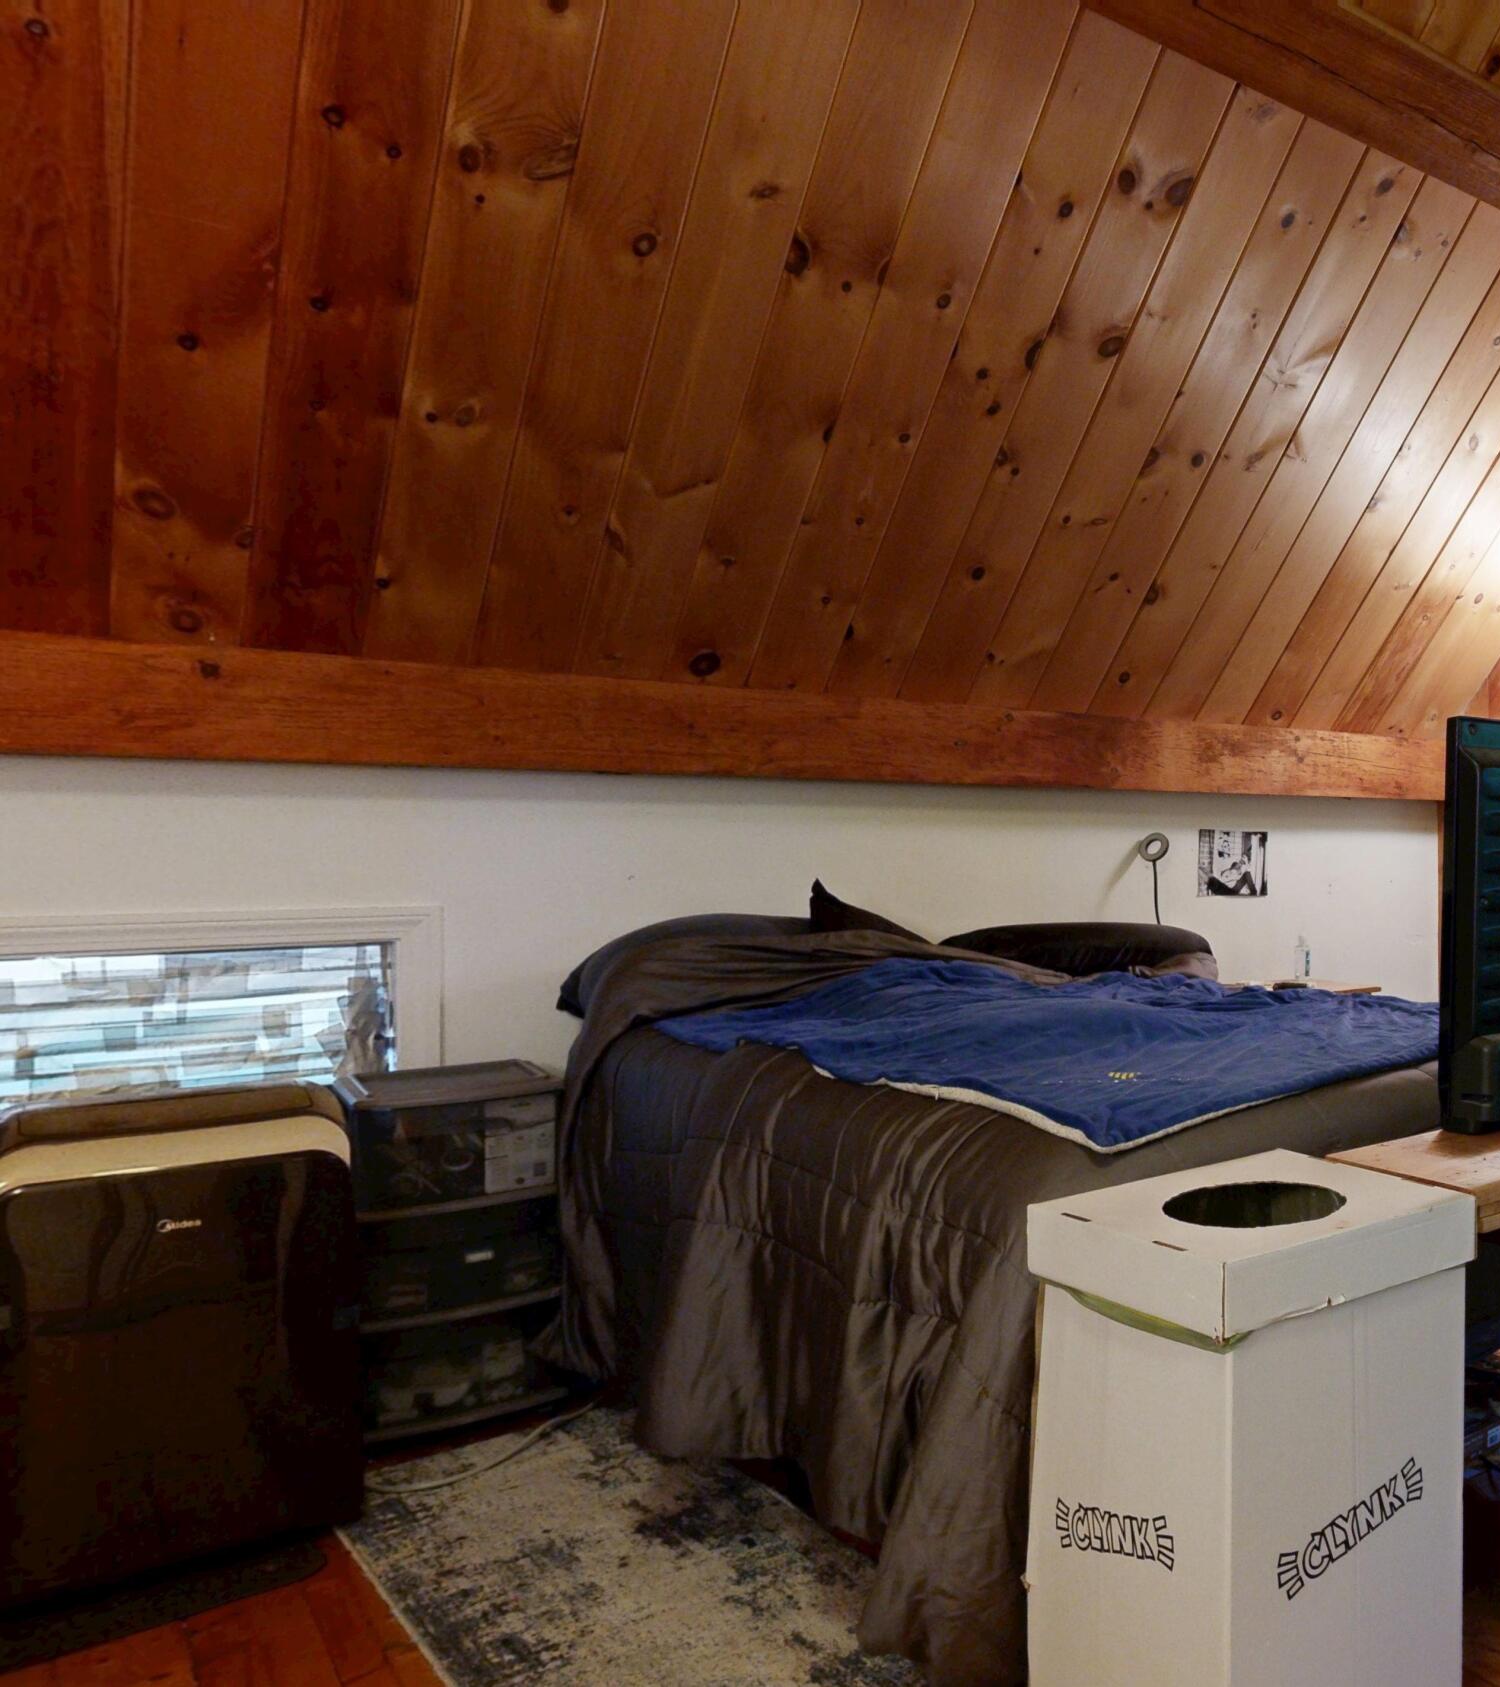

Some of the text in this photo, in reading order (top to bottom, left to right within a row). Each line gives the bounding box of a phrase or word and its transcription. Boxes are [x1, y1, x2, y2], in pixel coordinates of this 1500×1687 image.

[163, 1219, 203, 1232] Midea
[1071, 1503, 1155, 1560] CLYNK
[1303, 1472, 1405, 1578] CLYNK
